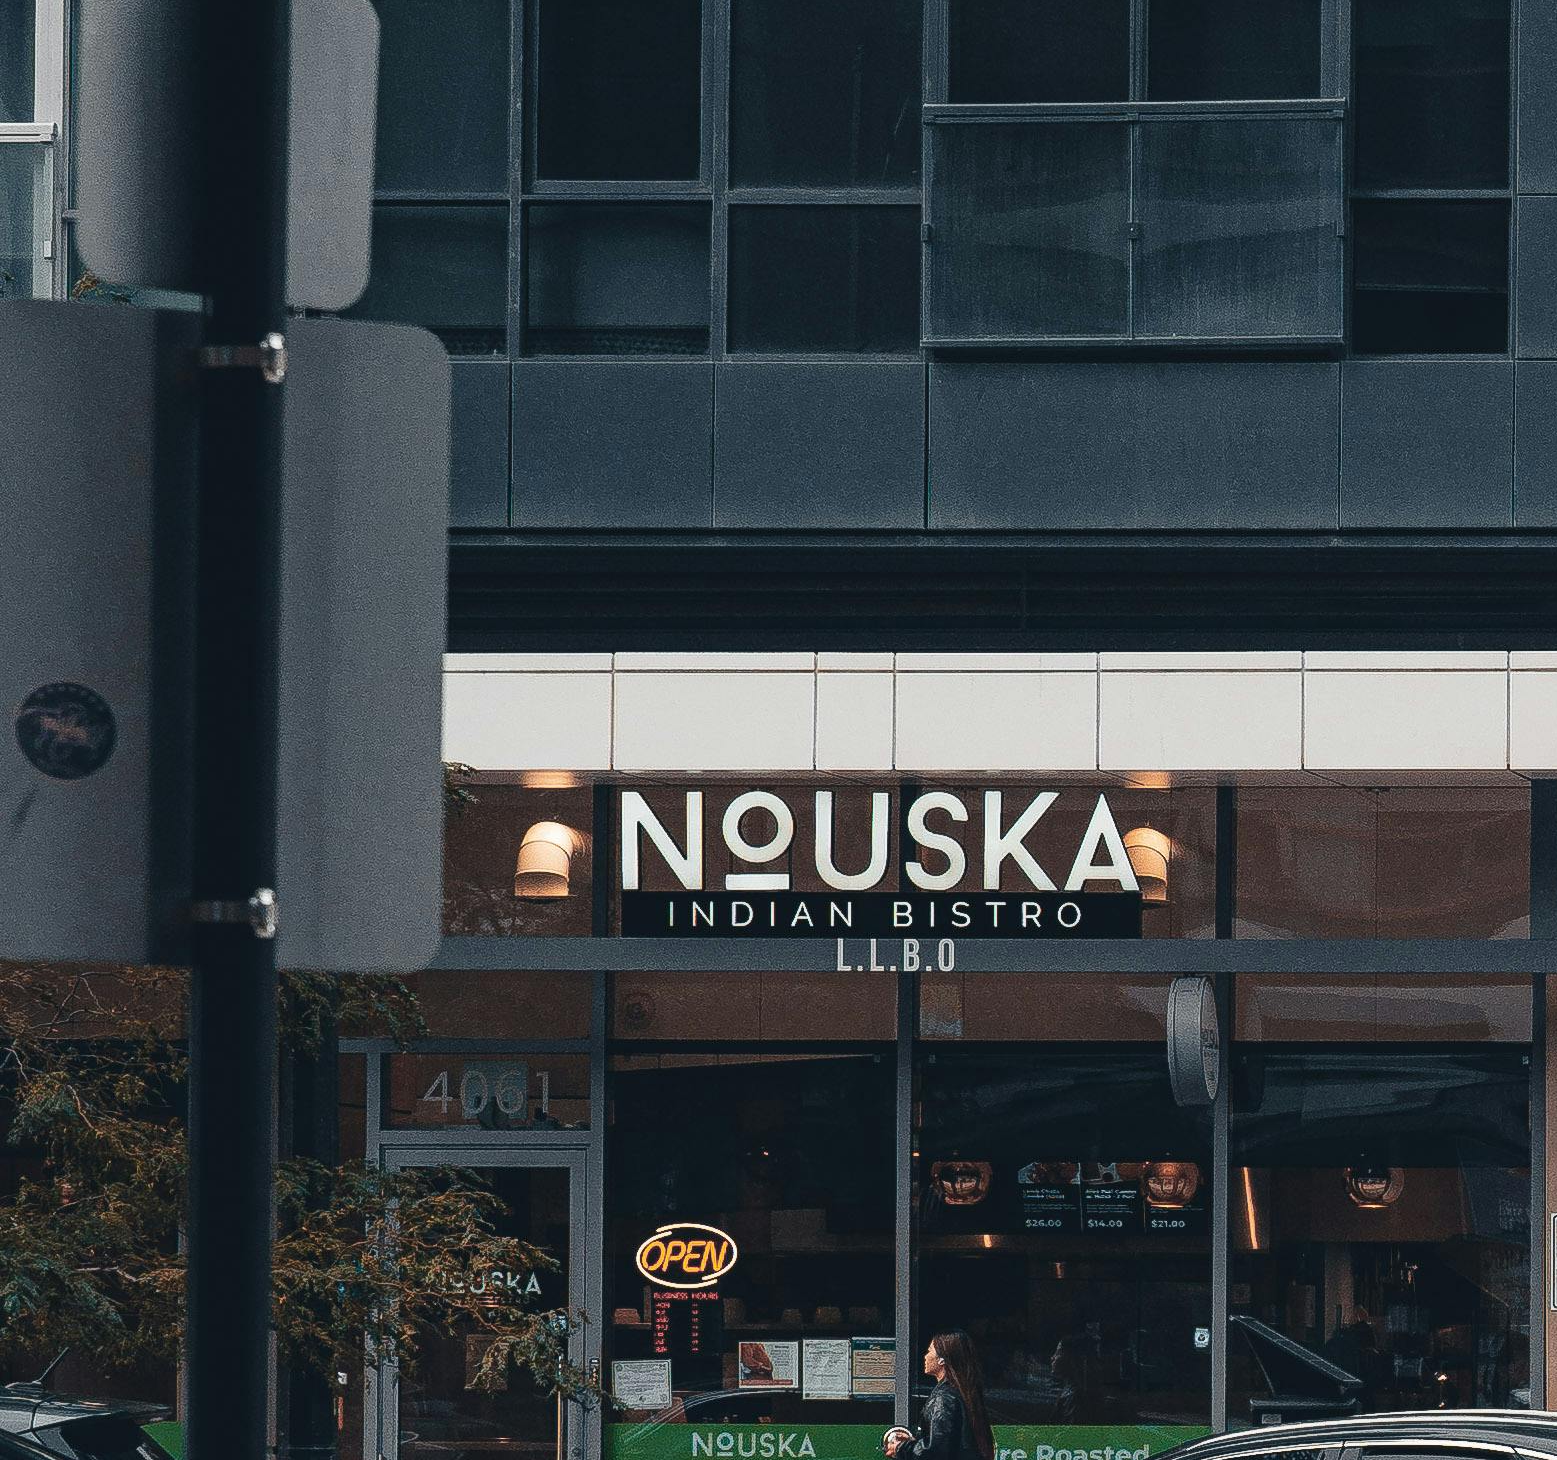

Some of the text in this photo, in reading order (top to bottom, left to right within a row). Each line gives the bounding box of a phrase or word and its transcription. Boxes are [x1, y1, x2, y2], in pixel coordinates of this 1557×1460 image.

[669, 901, 1083, 928] INDIAN BISTRO
[837, 938, 955, 972] L.L.B.O
[423, 1070, 550, 1114] 4061
[641, 1241, 728, 1272] OPEN
